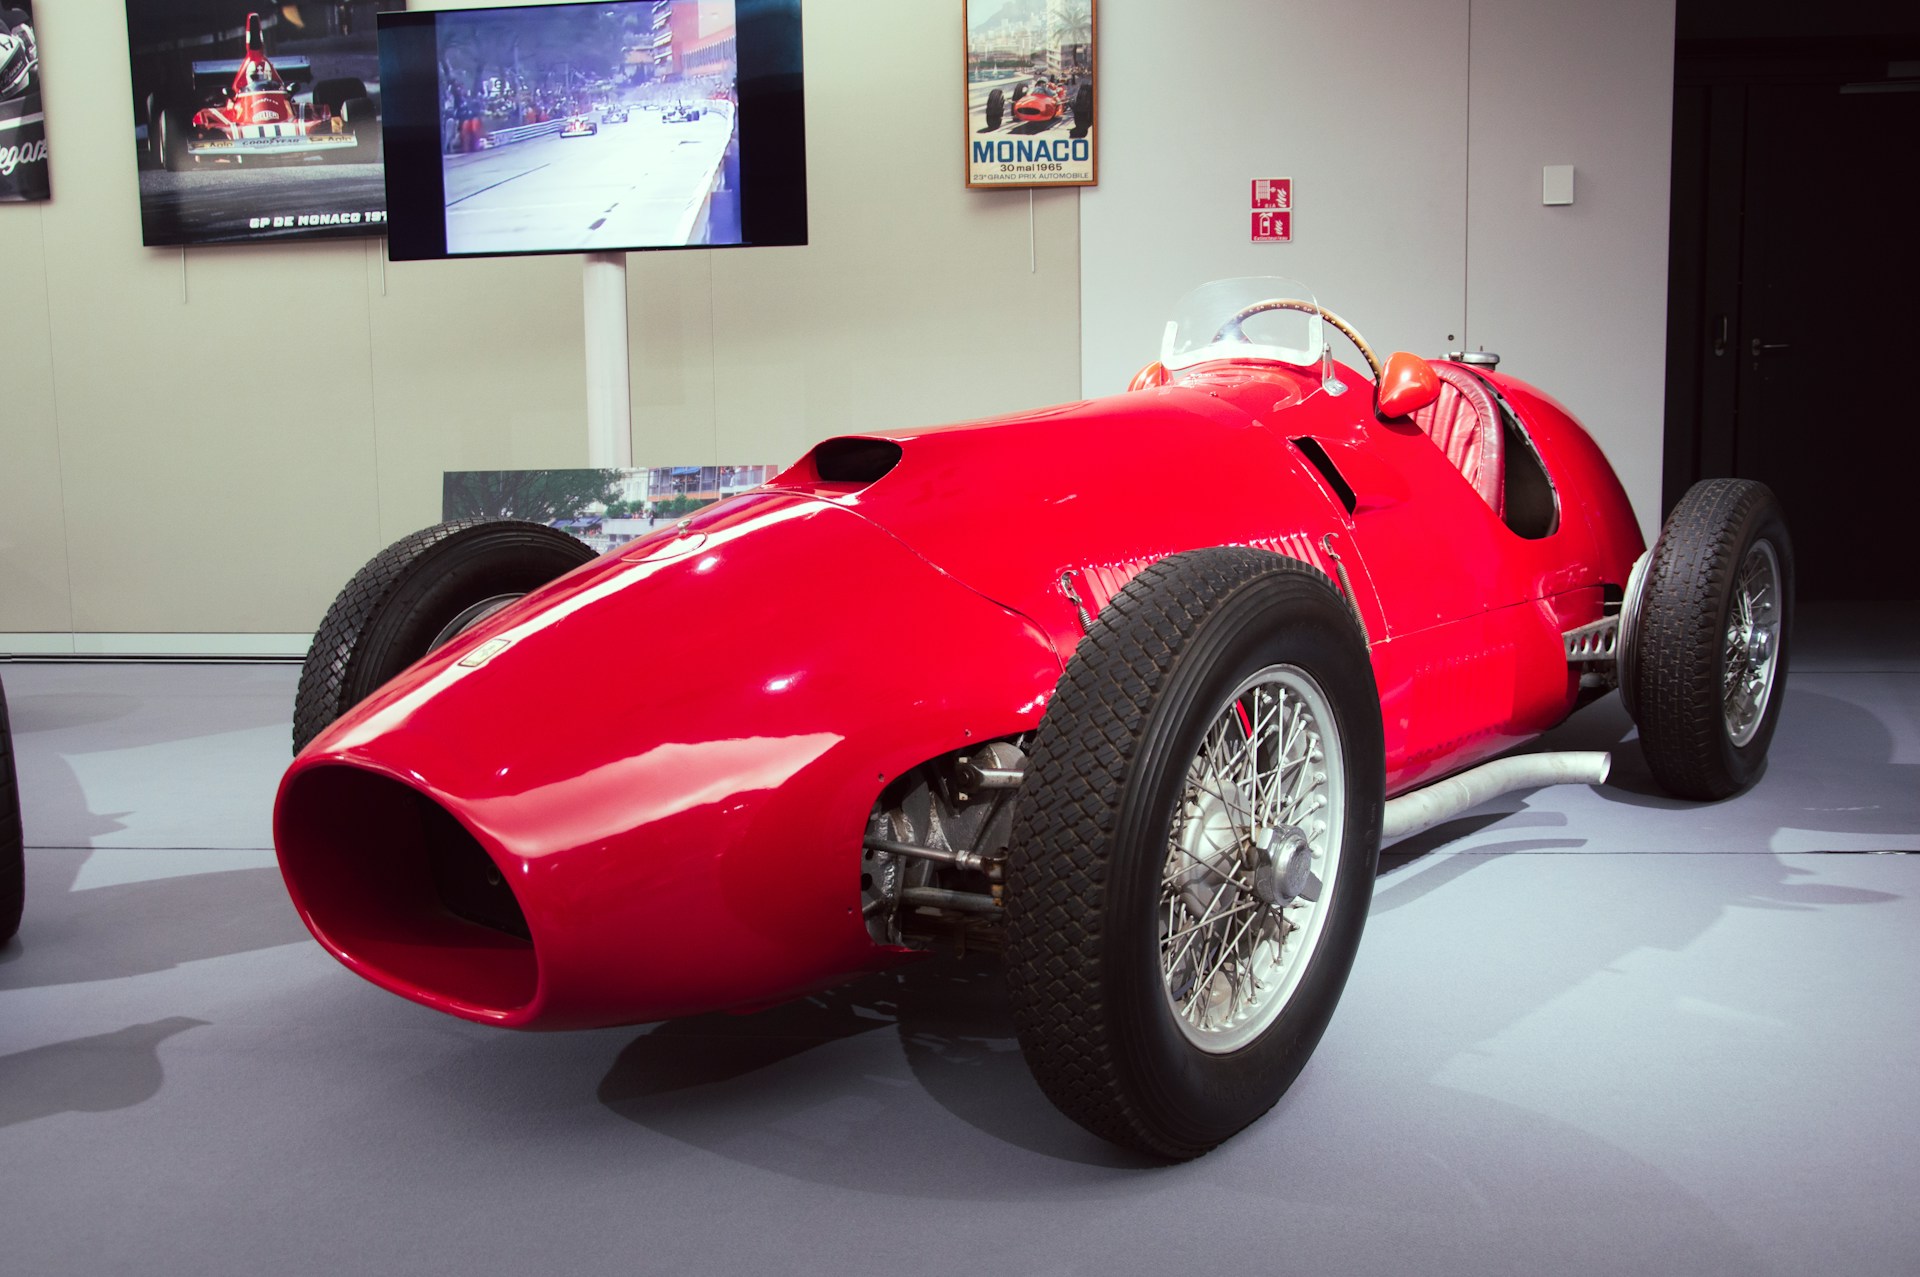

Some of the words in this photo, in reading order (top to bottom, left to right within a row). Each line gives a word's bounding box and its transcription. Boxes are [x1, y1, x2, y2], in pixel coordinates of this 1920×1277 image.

[973, 139, 1089, 163] MONACO
[1000, 164, 1015, 172] 30
[1016, 163, 1035, 171] mai
[1036, 163, 1063, 171] 1965
[249, 217, 271, 229] GP
[273, 216, 295, 228] DE
[298, 212, 361, 226] MONACO
